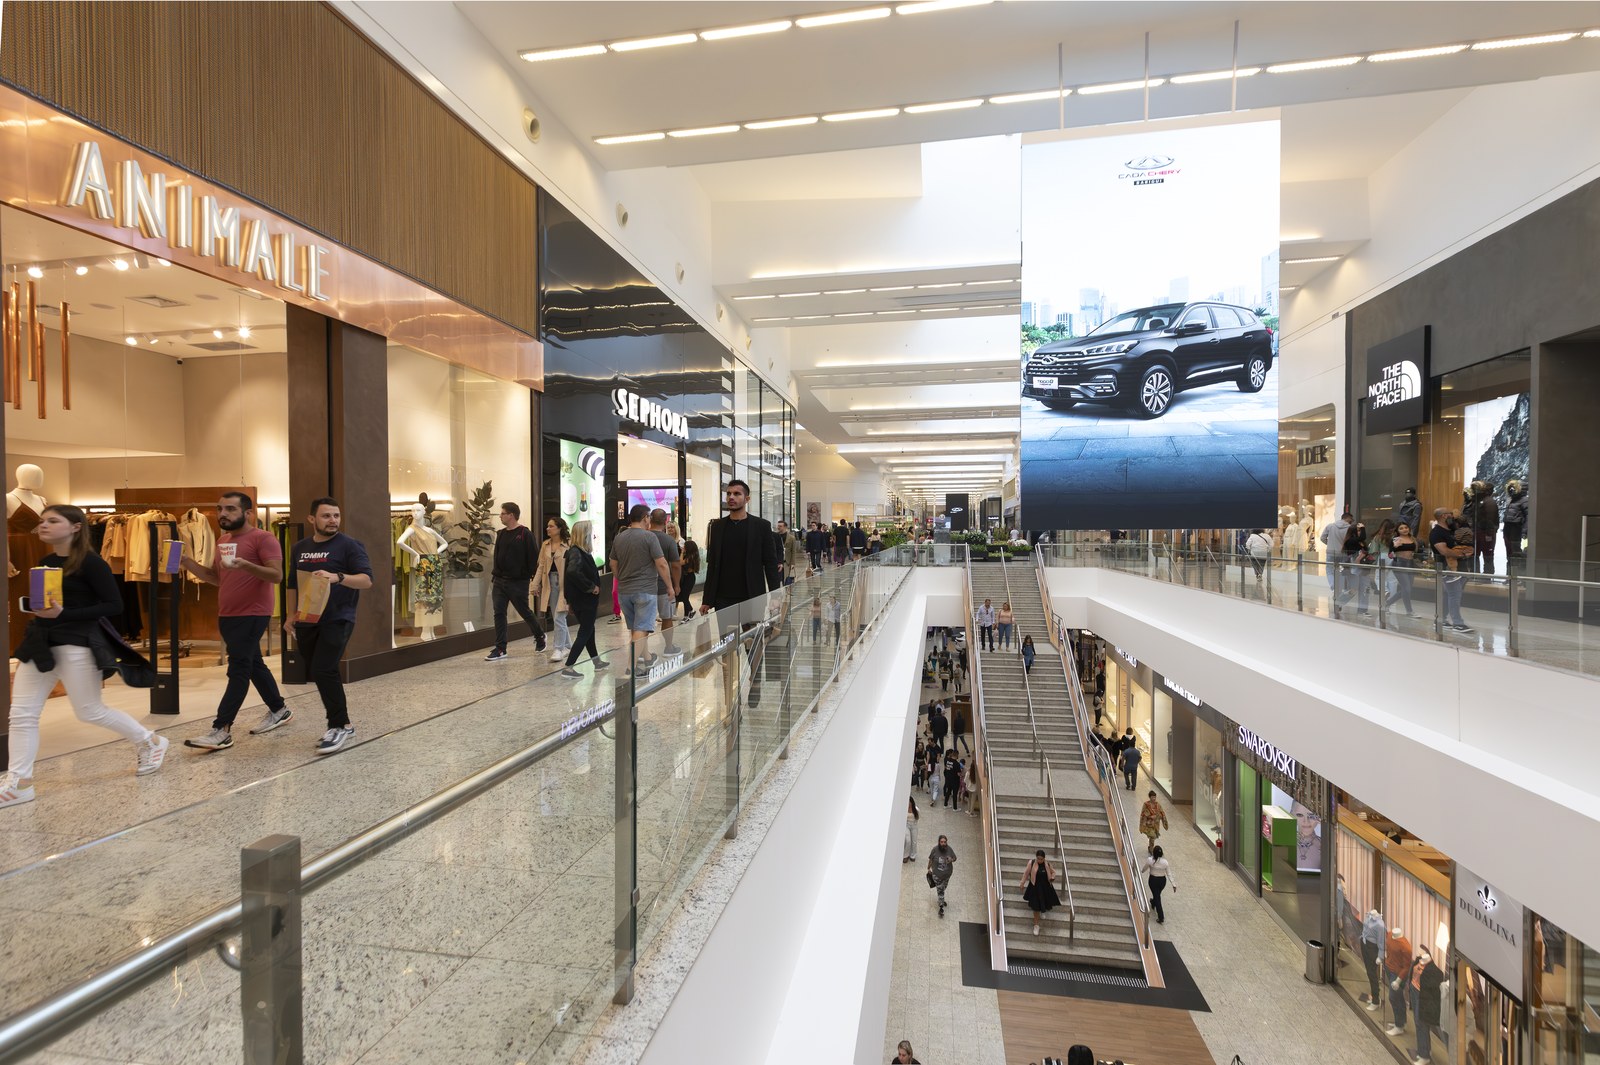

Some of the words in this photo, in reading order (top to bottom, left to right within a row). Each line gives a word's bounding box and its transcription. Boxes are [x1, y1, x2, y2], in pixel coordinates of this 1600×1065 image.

[1147, 169, 1182, 177] CHERY
[62, 141, 330, 301] ANIMALE
[1368, 376, 1401, 398] NORTH
[1382, 361, 1402, 380] THE
[612, 388, 689, 440] SEPHORA
[1376, 389, 1401, 408] FACE
[1238, 725, 1296, 781] SWAROVSKI
[1460, 897, 1516, 948] DUDALINA
